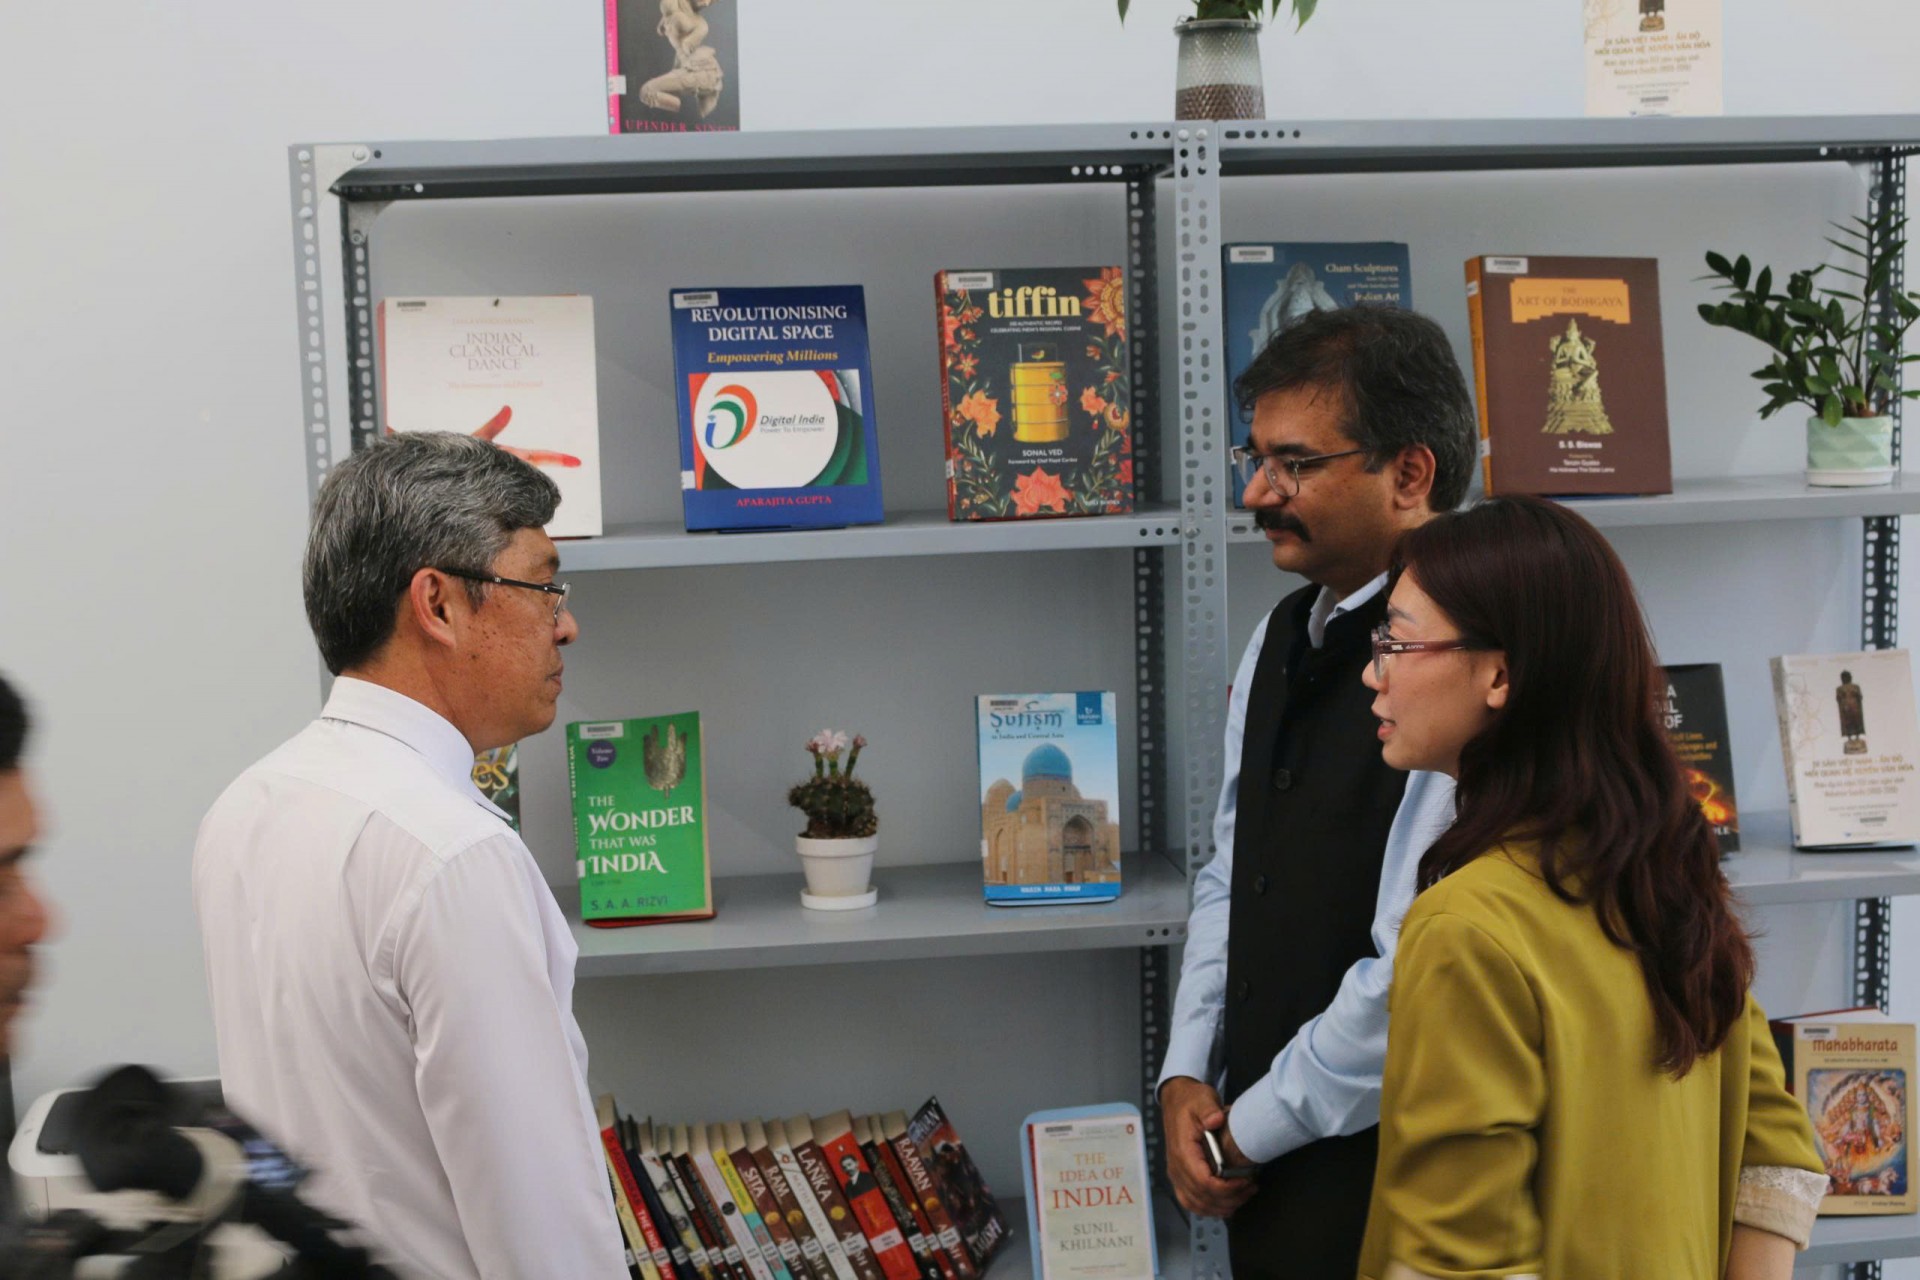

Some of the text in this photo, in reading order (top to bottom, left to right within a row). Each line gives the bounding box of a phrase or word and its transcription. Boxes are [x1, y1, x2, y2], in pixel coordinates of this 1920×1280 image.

[625, 120, 688, 132] UPINDER
[1325, 263, 1398, 275] Cham Sculptures
[987, 286, 1082, 318] tiffin
[1354, 292, 1400, 301] Indian Art
[1517, 296, 1539, 305] ART
[1543, 297, 1556, 306] OF
[691, 305, 848, 322] REVOLUTIONISING
[466, 332, 523, 345] INDIAN
[708, 325, 834, 341] DIGITAL SPACE
[449, 344, 537, 358] CLASSICAL
[707, 350, 839, 365] Empowering Millions
[467, 358, 521, 371] DANCE
[760, 414, 825, 427] Digital India
[1022, 448, 1063, 457] SONAL VED
[737, 495, 832, 507] APARAJITA GUPTA
[1664, 713, 1683, 729] OF
[588, 795, 615, 807] THE
[588, 805, 695, 836] WONDER
[589, 834, 657, 850] THAT WAS
[588, 851, 668, 875] INDIA
[637, 896, 668, 908] RIZVI
[898, 1137, 933, 1191] RAAVAN
[1073, 1152, 1107, 1166] THE
[767, 1164, 790, 1198] RAM
[797, 1147, 833, 1202] LANKA
[1060, 1167, 1124, 1183] IDEA OF
[743, 1165, 767, 1200] SITA
[1052, 1184, 1135, 1209] INDIA
[636, 1208, 651, 1228] THE
[1073, 1221, 1118, 1236] SUNIL
[1060, 1235, 1134, 1252] KHILNANI
